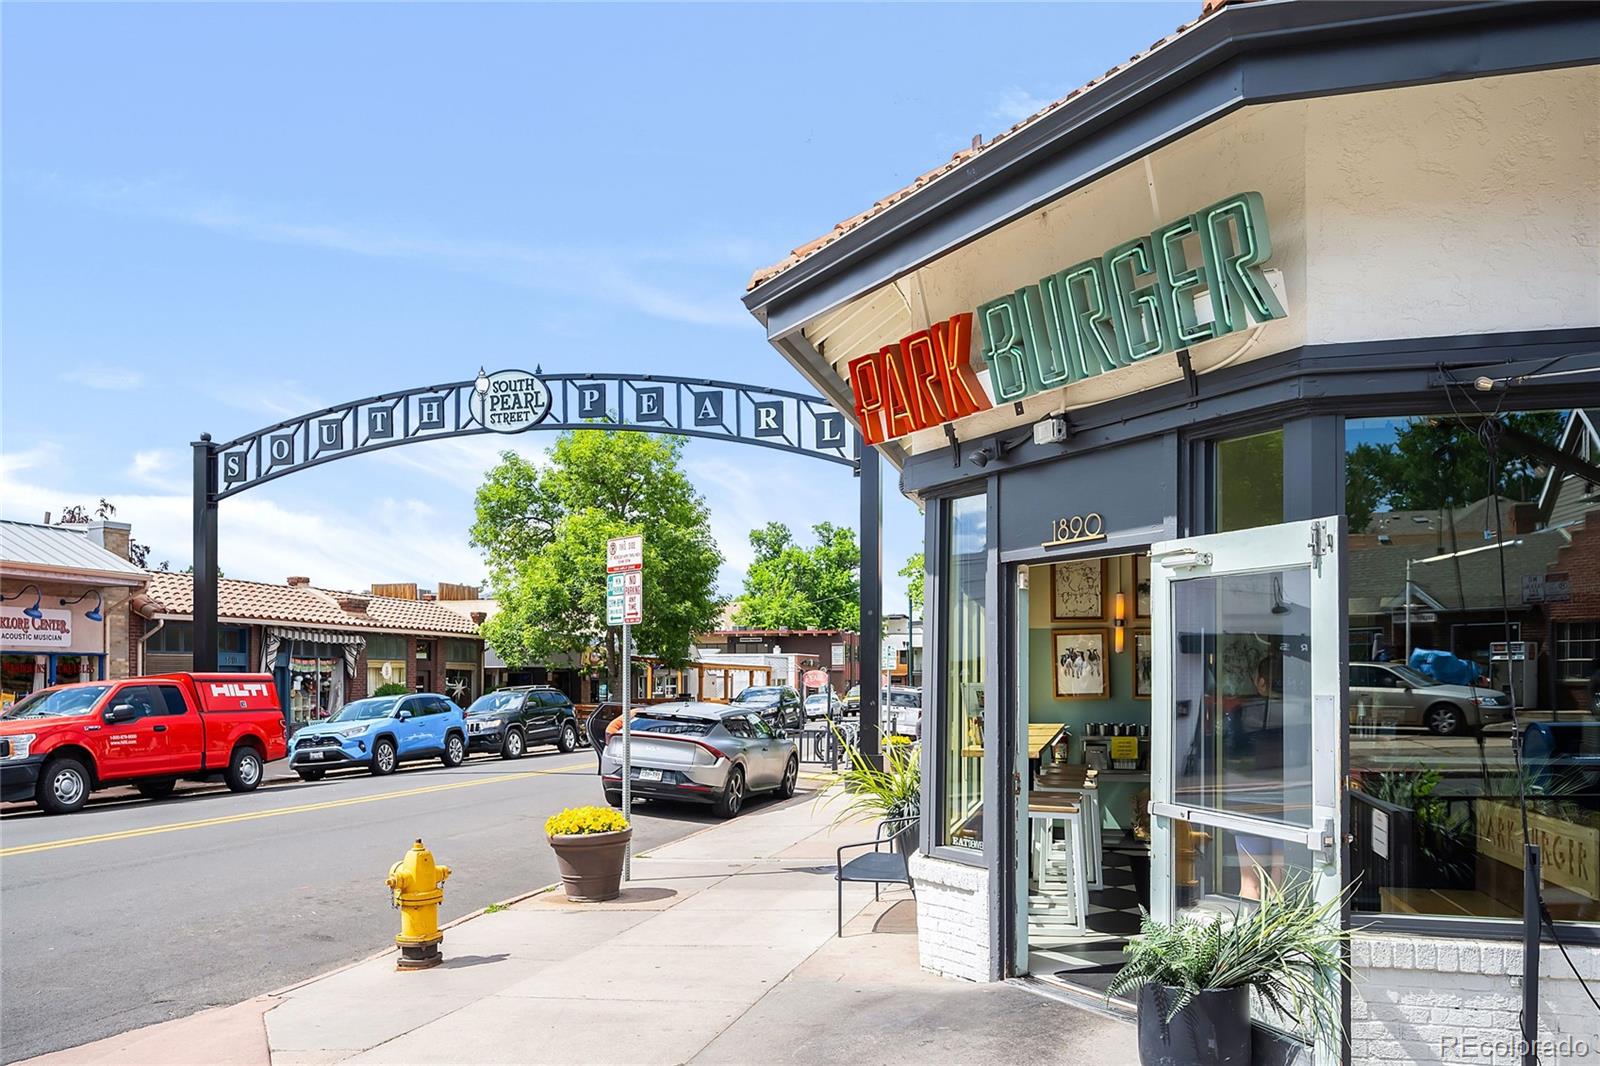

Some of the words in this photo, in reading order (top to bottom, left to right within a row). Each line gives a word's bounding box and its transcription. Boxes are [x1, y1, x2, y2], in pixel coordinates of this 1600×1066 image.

[848, 312, 993, 446] PARK
[976, 191, 1288, 405] BURGER
[492, 378, 534, 393] SOUTH
[490, 391, 545, 415] PEARL
[490, 411, 530, 425] STREET
[226, 400, 442, 478] SOUTH
[581, 388, 842, 442] PEARL
[1052, 513, 1102, 543] 1890
[31, 617, 70, 634] CENTER
[1, 633, 32, 641] ACOUSTIC
[210, 683, 269, 697] HILTI
